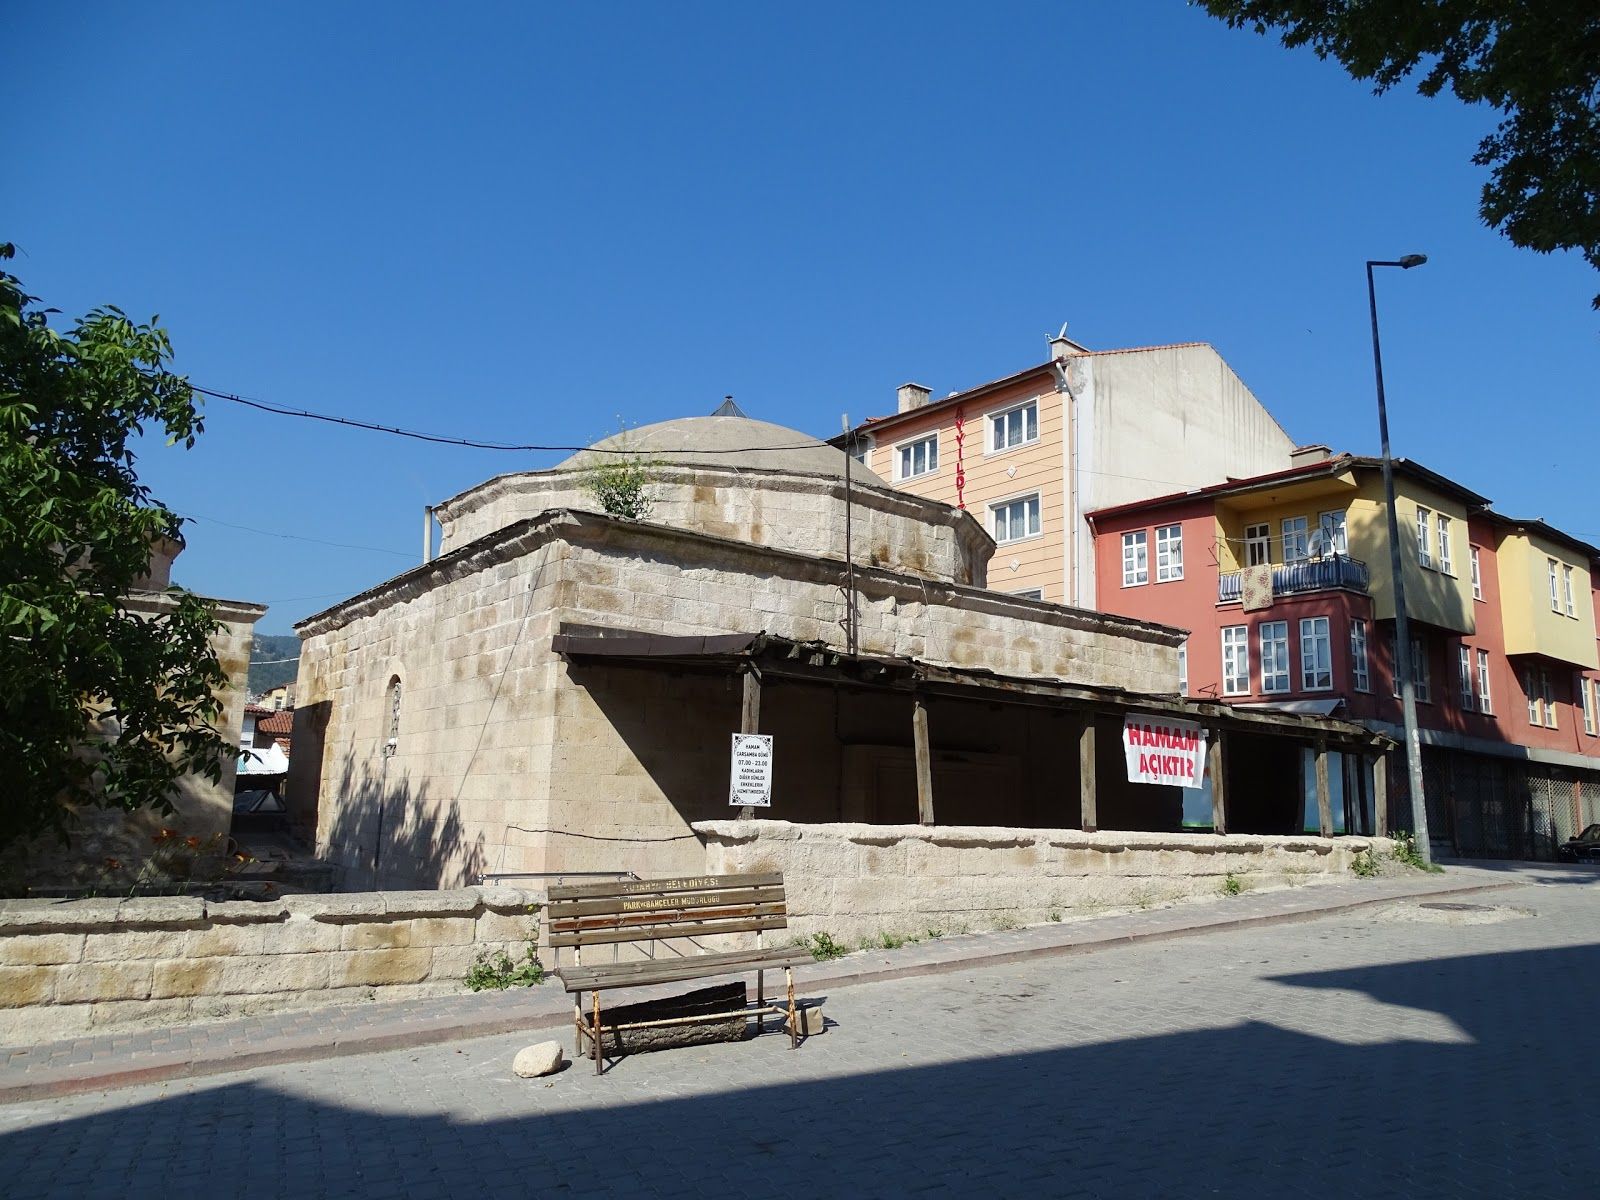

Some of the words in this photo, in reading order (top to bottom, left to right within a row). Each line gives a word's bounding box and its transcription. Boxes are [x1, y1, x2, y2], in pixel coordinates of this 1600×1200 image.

[1127, 723, 1199, 752] HAMAM
[1139, 753, 1195, 780] AÇIKTIR
[623, 900, 641, 910] PARK
